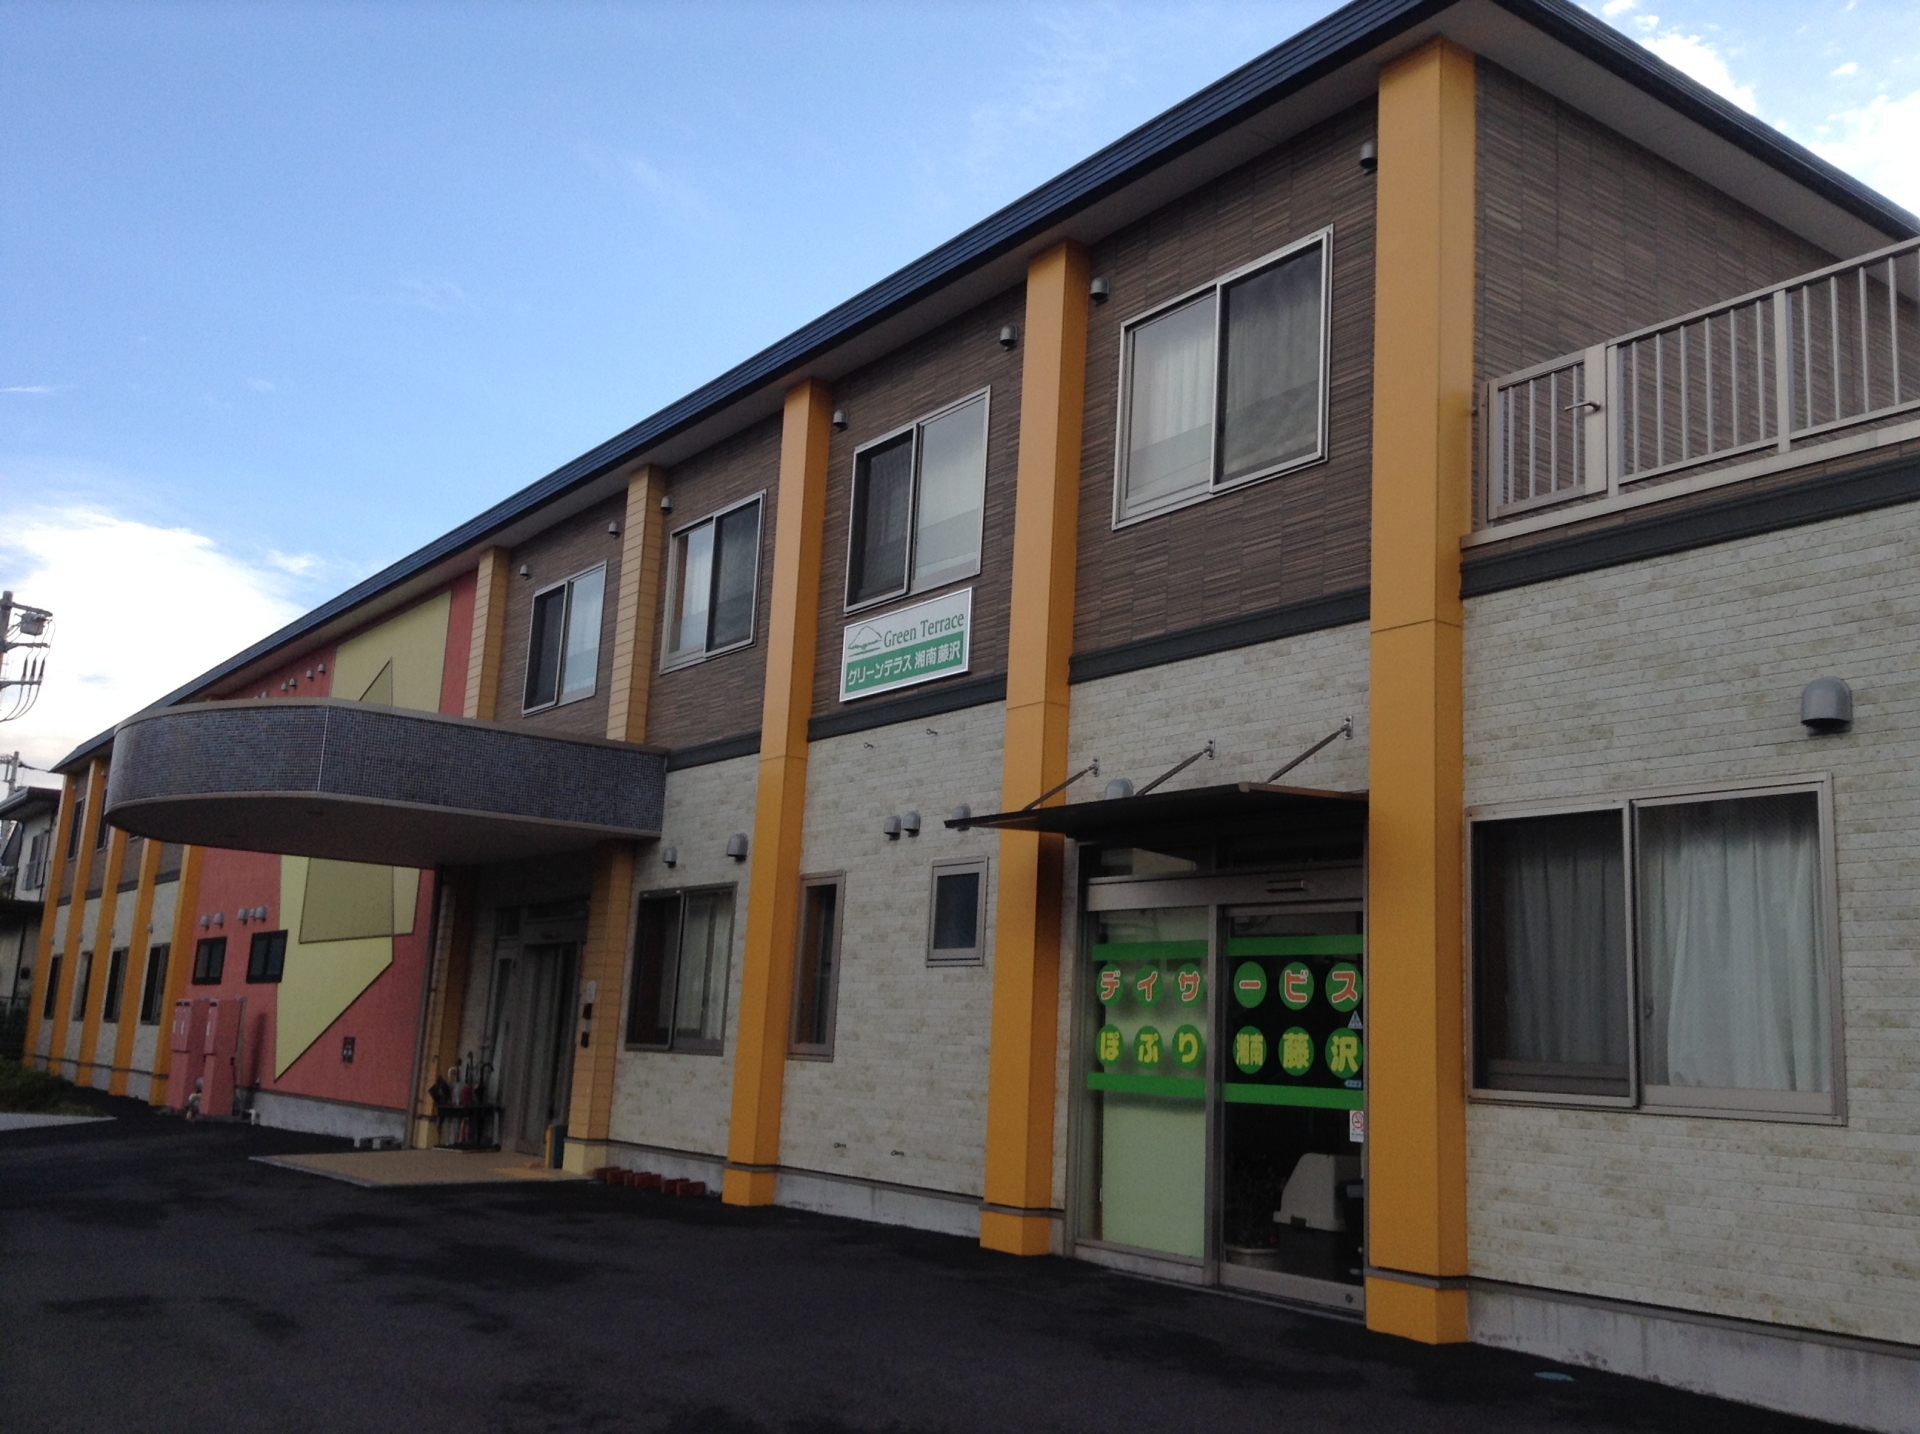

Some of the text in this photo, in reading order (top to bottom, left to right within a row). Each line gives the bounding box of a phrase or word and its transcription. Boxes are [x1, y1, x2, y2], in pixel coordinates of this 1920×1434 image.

[884, 613, 964, 648] Green Terrace
[848, 640, 961, 686] グリーンテラス 湘南藤沢
